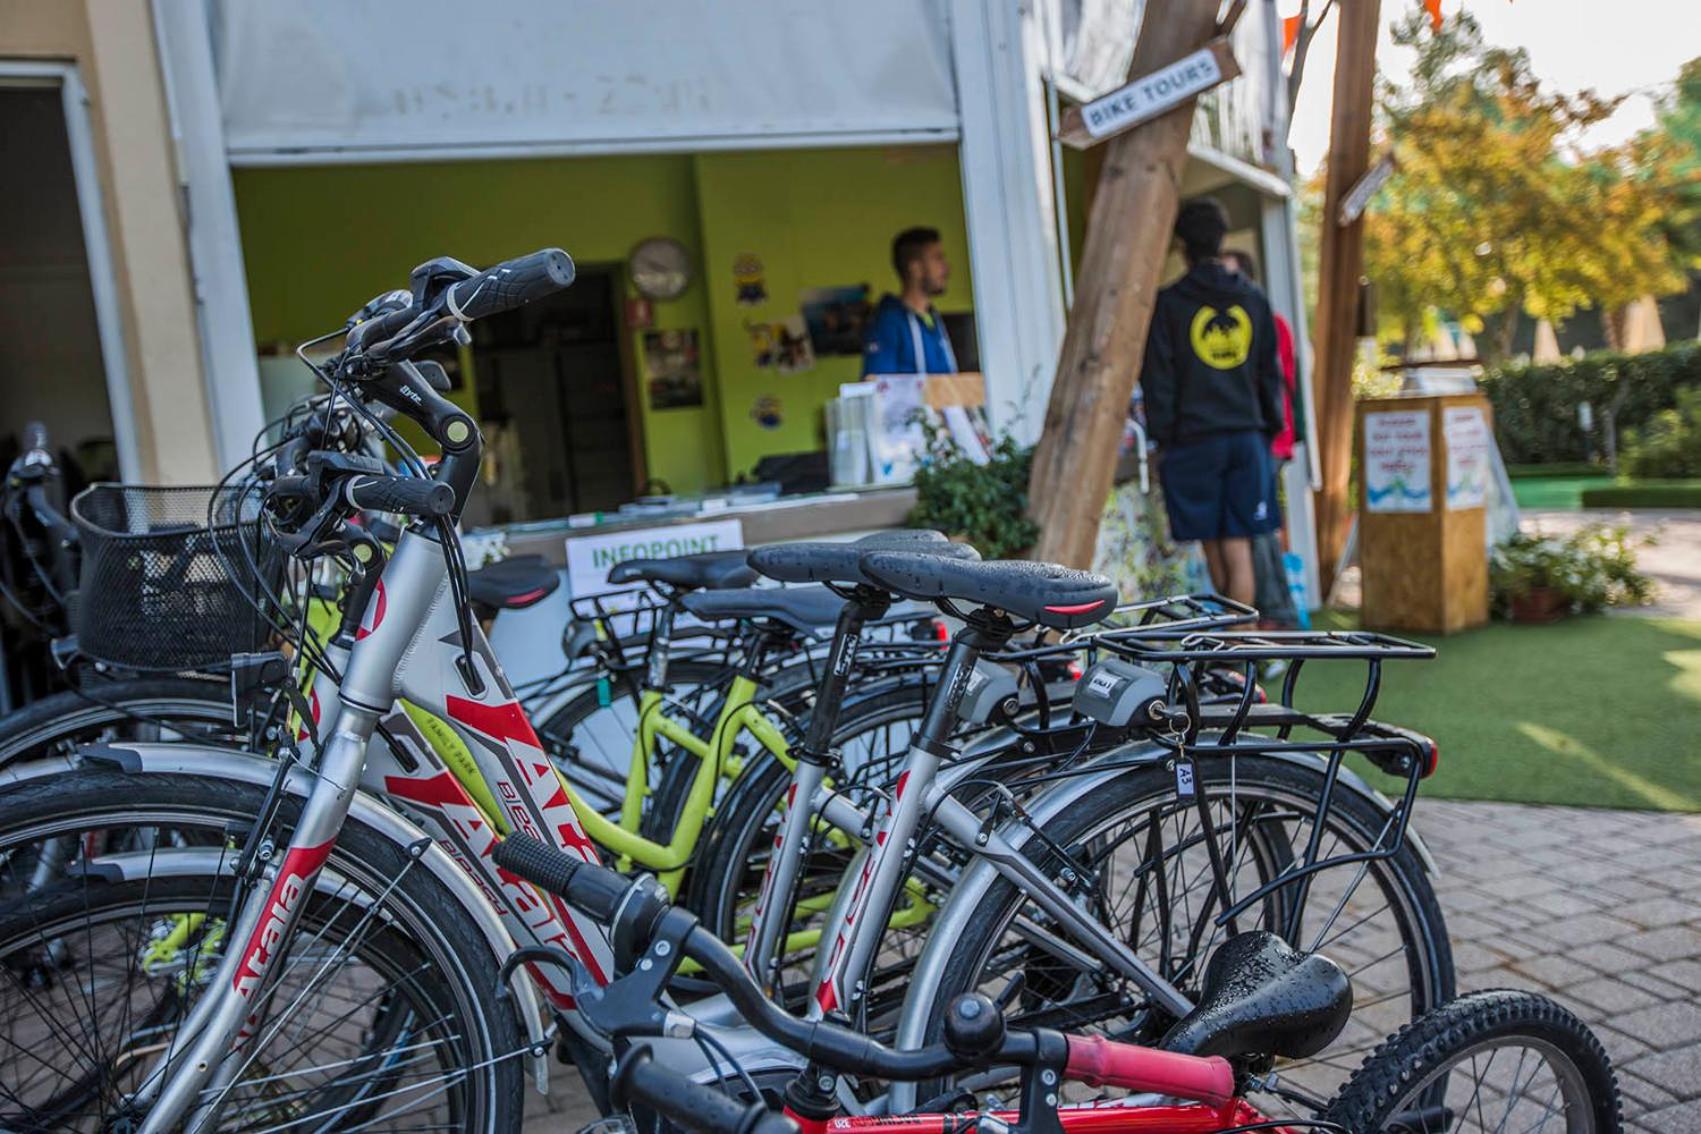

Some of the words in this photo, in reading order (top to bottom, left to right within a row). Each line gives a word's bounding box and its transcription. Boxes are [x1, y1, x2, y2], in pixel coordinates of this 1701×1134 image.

[1090, 94, 1137, 126] BIKE
[1142, 61, 1213, 100] TOURS
[592, 535, 719, 567] INFOPOINT
[1180, 767, 1192, 785] A3
